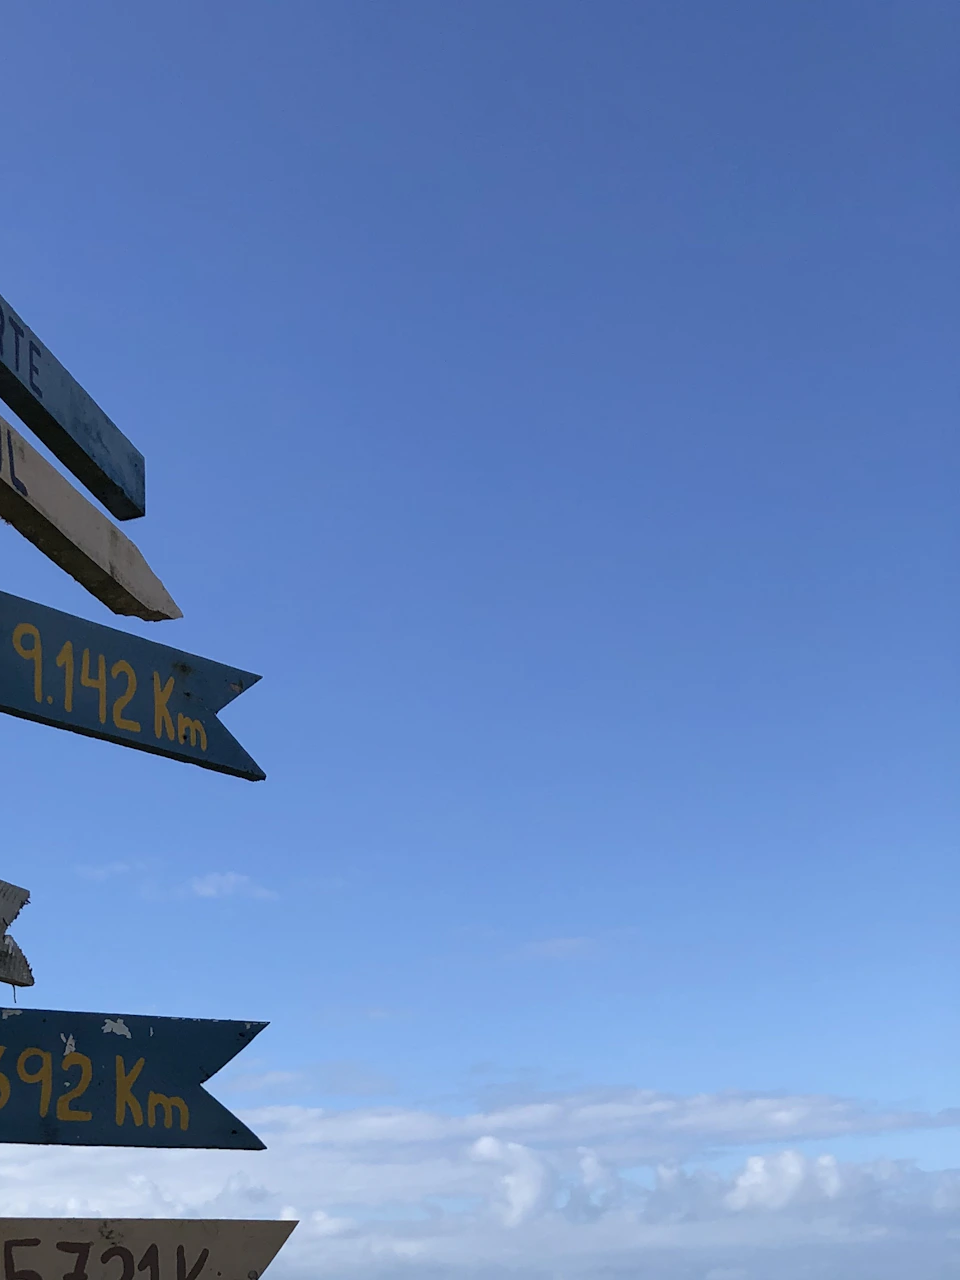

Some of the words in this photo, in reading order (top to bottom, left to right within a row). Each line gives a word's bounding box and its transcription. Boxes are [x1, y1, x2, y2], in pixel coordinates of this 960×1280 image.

[12, 623, 141, 732] 9.142
[153, 671, 208, 752] Km
[115, 1055, 190, 1131] Km
